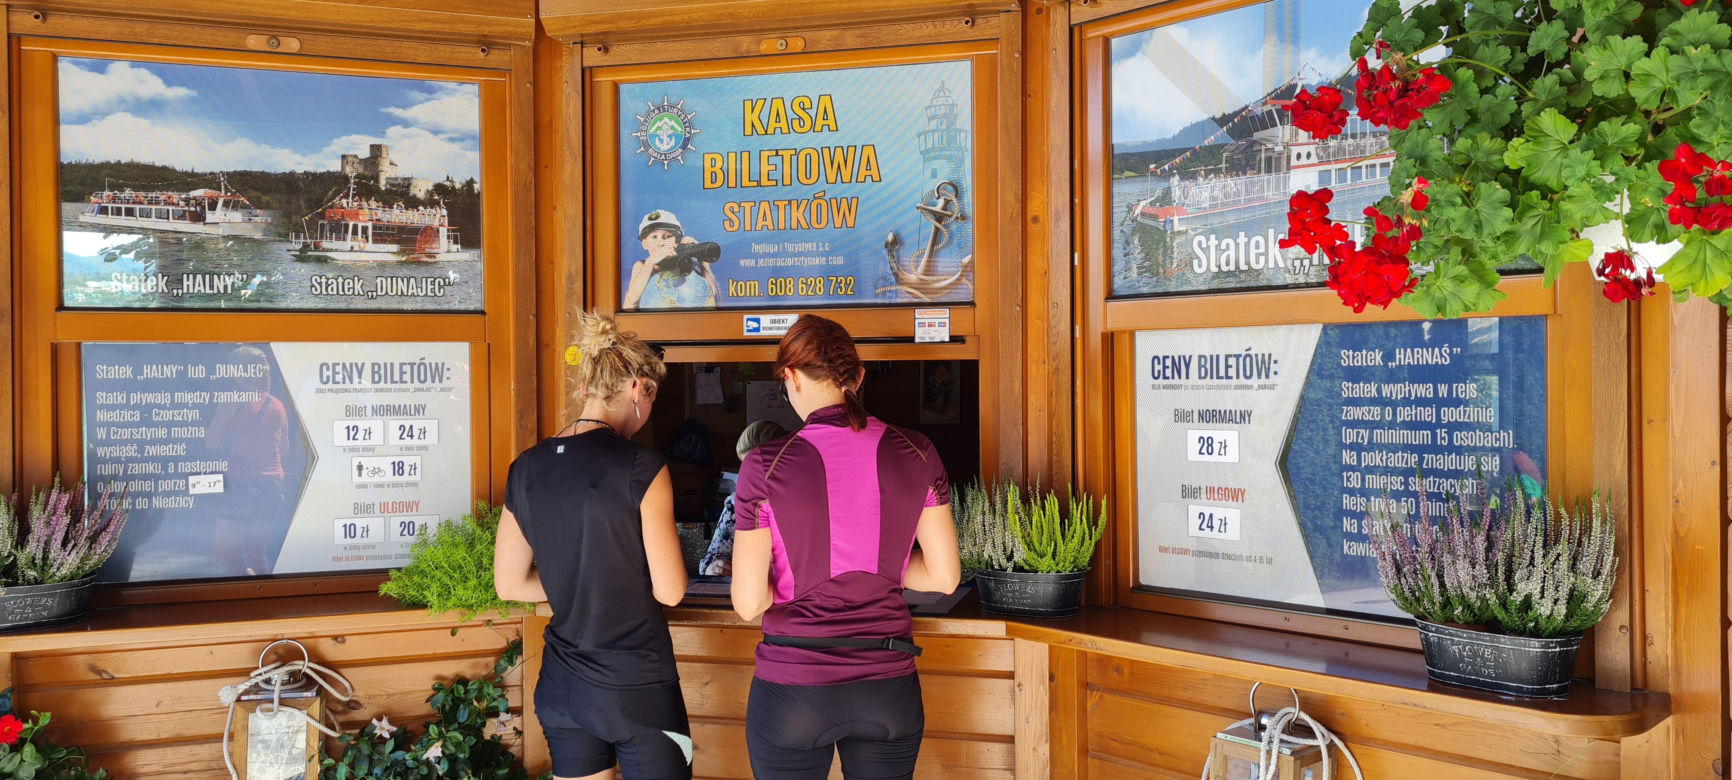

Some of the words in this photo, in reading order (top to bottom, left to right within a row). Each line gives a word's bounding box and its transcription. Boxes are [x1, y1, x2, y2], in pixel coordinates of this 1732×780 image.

[743, 94, 838, 136] KASA
[703, 144, 881, 189] BILETOWA
[723, 190, 859, 232] STATKÓW
[1193, 228, 1285, 274] Statek
[111, 272, 168, 294] Statek
[311, 275, 364, 296] Statek
[728, 278, 764, 297] kom.
[768, 277, 794, 296] 608
[798, 276, 824, 296] 628
[828, 275, 855, 295] 732
[1151, 354, 1192, 380] CENY
[1198, 347, 1278, 380] BILETÓW:
[1341, 349, 1383, 366] Statek
[96, 364, 133, 379] Statek
[188, 364, 206, 378] lub
[318, 362, 366, 385] CENY
[371, 356, 451, 385] BILETÓW:
[96, 391, 126, 405] Statki
[130, 391, 170, 407] pływają
[175, 390, 210, 406] między
[213, 390, 262, 403] zamkami:
[1342, 381, 1378, 398] Statek
[1382, 381, 1433, 399] wypływa
[1438, 383, 1448, 397] w
[1452, 380, 1477, 399] rejs
[96, 409, 140, 422] Niedzica
[152, 408, 202, 421] Czorsztyn.
[345, 405, 367, 418] Bilet
[371, 404, 427, 417] NORMALNY
[1174, 408, 1194, 423] Bilet
[1198, 409, 1252, 424] NORMALNY
[1342, 406, 1381, 421] zawsze
[1385, 407, 1392, 421] o
[1397, 404, 1436, 423] pełnej
[1441, 404, 1494, 422] godzinie
[96, 428, 107, 440] W
[110, 426, 168, 440] Czorsztynie
[171, 425, 205, 438] można
[345, 425, 359, 441] 12
[362, 426, 372, 440] zł
[398, 424, 414, 440] 24
[417, 426, 427, 440] zł
[1342, 427, 1369, 445] (przy
[1373, 427, 1431, 445] minimum
[1436, 428, 1448, 445] 15
[1453, 430, 1517, 448] osobach).
[96, 444, 141, 461] wysiąść,
[144, 443, 187, 456] zwiedzić
[1198, 436, 1214, 455] 28
[1217, 439, 1227, 456] zł
[97, 463, 124, 477] ruiny
[127, 461, 164, 475] zamku,
[168, 463, 174, 473] a
[178, 459, 228, 475] następnie
[391, 460, 405, 476] 18
[408, 462, 418, 476] zł
[1342, 449, 1356, 465] Na
[1361, 449, 1418, 468] pokładzie
[1422, 452, 1477, 472] znajduje
[1481, 454, 1500, 477] się
[97, 482, 104, 493] o
[158, 479, 185, 492] porze
[1342, 472, 1361, 488] 130
[1366, 473, 1404, 491] miejsc
[136, 497, 148, 510] do
[152, 495, 197, 510] Niedzicy.
[1181, 484, 1202, 499] Bilet
[1205, 485, 1246, 503] ULGOWY
[353, 502, 375, 515] Bilet
[379, 500, 420, 514] ULGOWY
[1343, 494, 1367, 512] Rejs
[1401, 498, 1415, 514] 50
[342, 523, 357, 539] 10
[360, 524, 370, 538] zł
[400, 521, 415, 537] 20
[1198, 512, 1214, 532] 24
[1217, 516, 1228, 533] zł
[1343, 516, 1358, 533] Na
